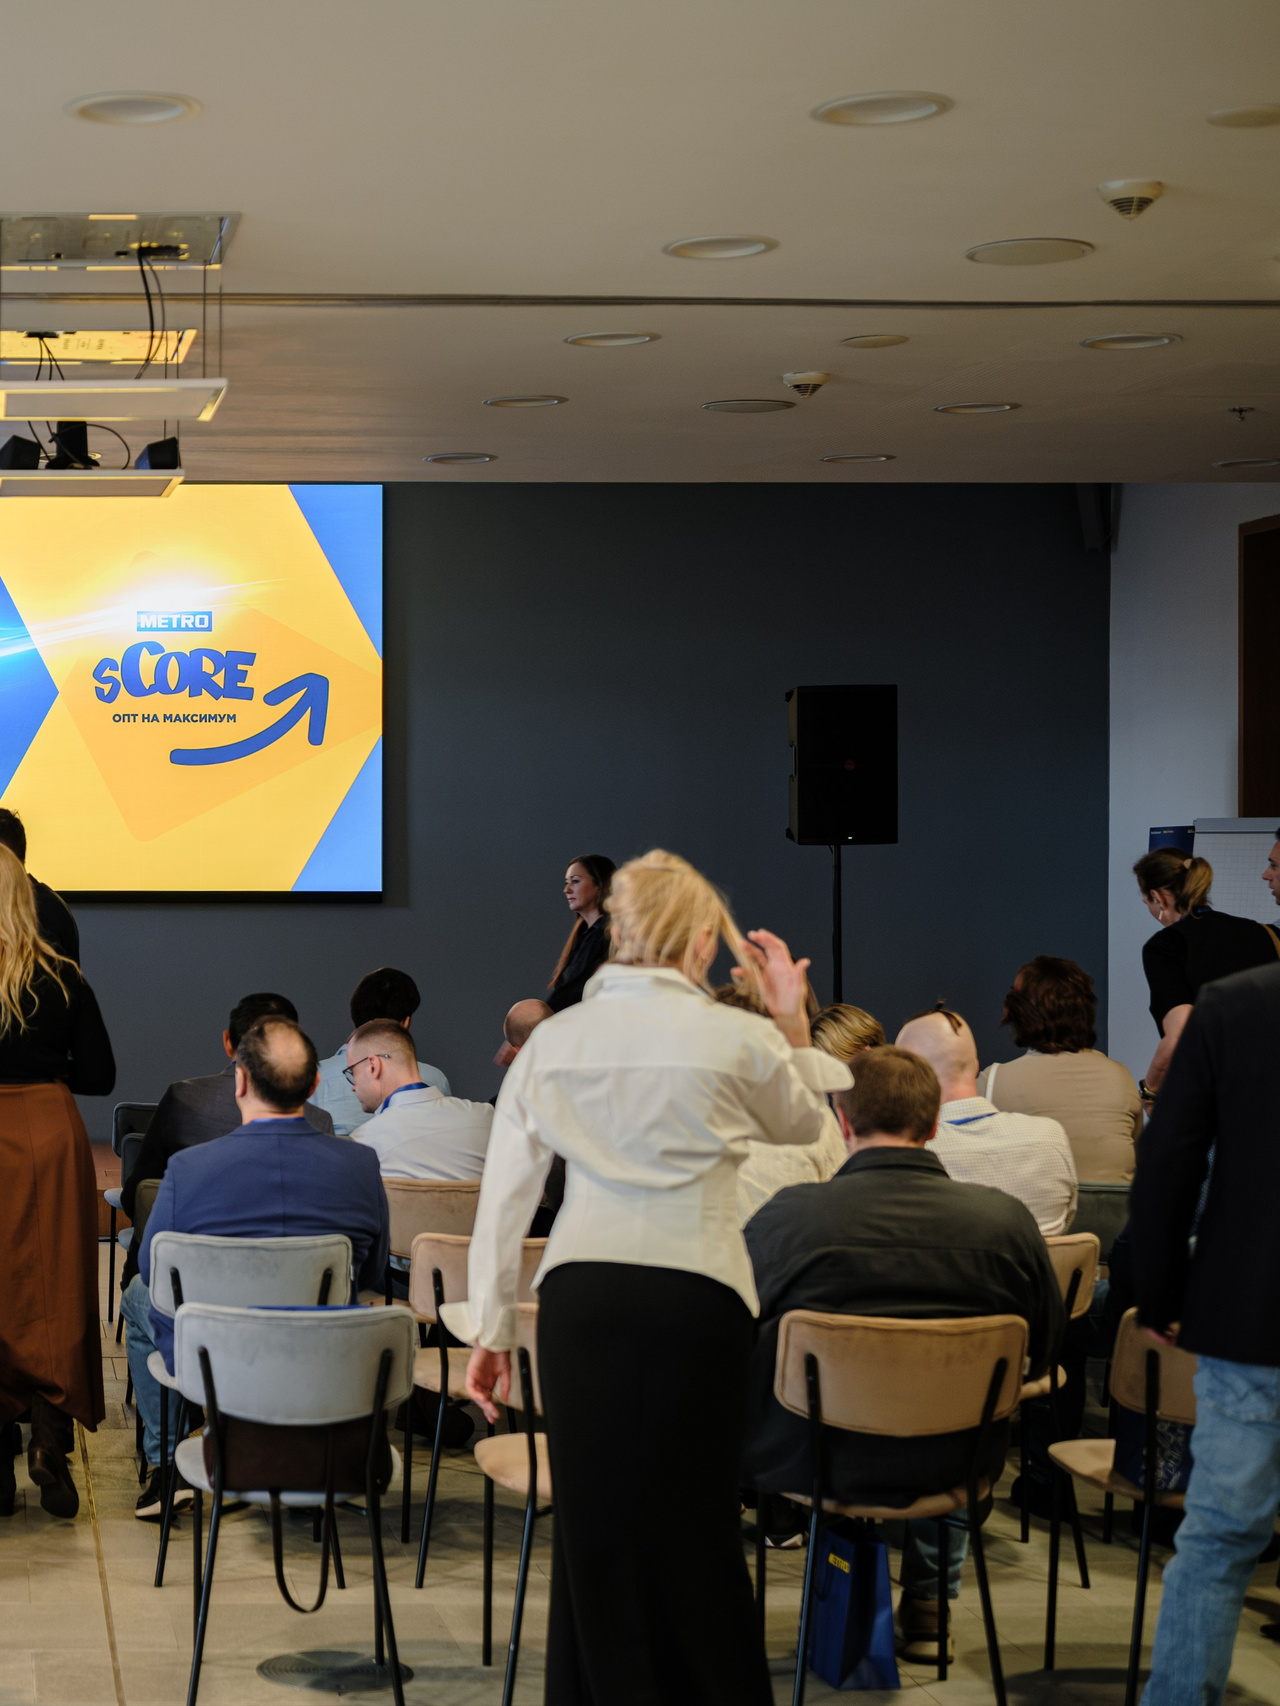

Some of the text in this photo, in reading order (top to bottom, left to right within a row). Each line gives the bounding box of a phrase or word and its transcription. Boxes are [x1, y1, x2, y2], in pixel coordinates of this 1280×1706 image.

[139, 614, 209, 629] METRO
[112, 713, 237, 723] ОПТ НА МАКСИМУМ
